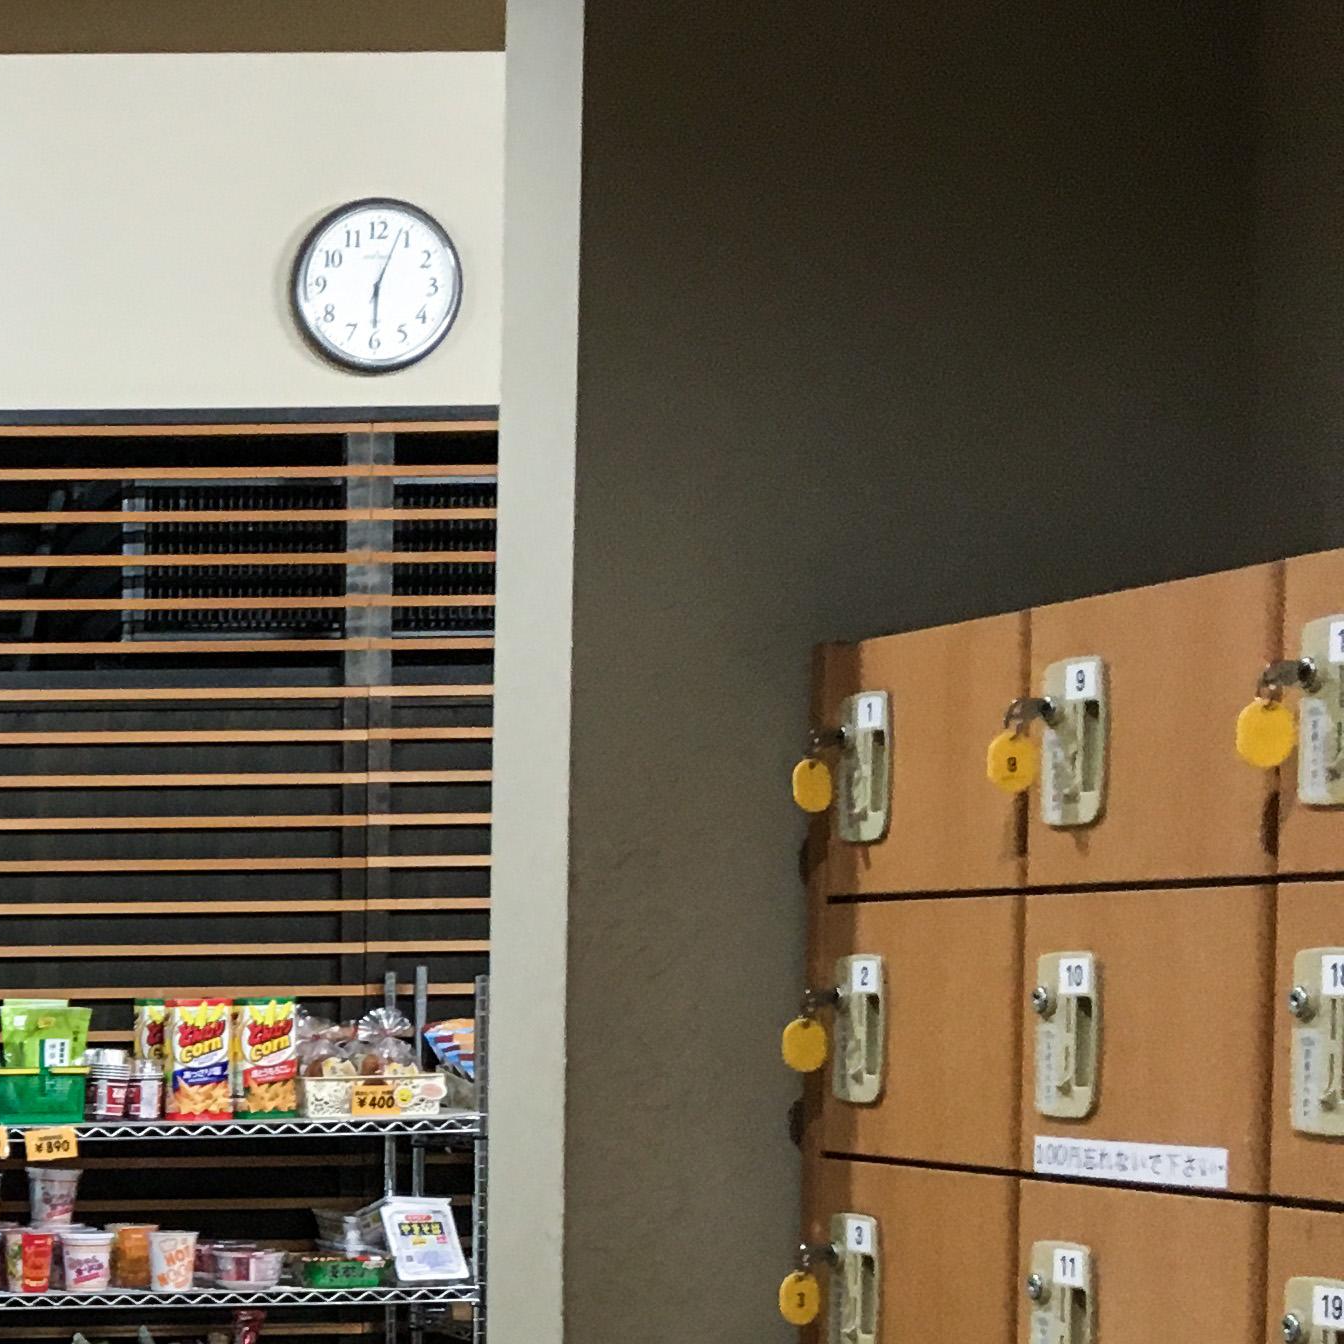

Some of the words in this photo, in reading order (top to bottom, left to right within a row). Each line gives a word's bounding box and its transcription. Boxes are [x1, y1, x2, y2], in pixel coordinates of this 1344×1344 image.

[345, 230, 361, 247] 11
[369, 221, 388, 239] 12
[403, 230, 410, 248] 1
[324, 251, 343, 267] 10
[420, 251, 432, 268] 2
[315, 277, 327, 294] 9
[427, 278, 438, 296] 3
[323, 305, 335, 322] 8
[416, 305, 427, 324] 4
[346, 324, 357, 341] 7
[369, 331, 381, 349] 6
[397, 325, 408, 342] 5
[1076, 671, 1085, 692] 9
[866, 703, 873, 721] 1
[860, 967, 869, 986] 2
[1066, 965, 1083, 986] 10
[855, 1226, 863, 1245] 3
[1060, 1256, 1076, 1278] 11
[1321, 1294, 1344, 1320] 19
